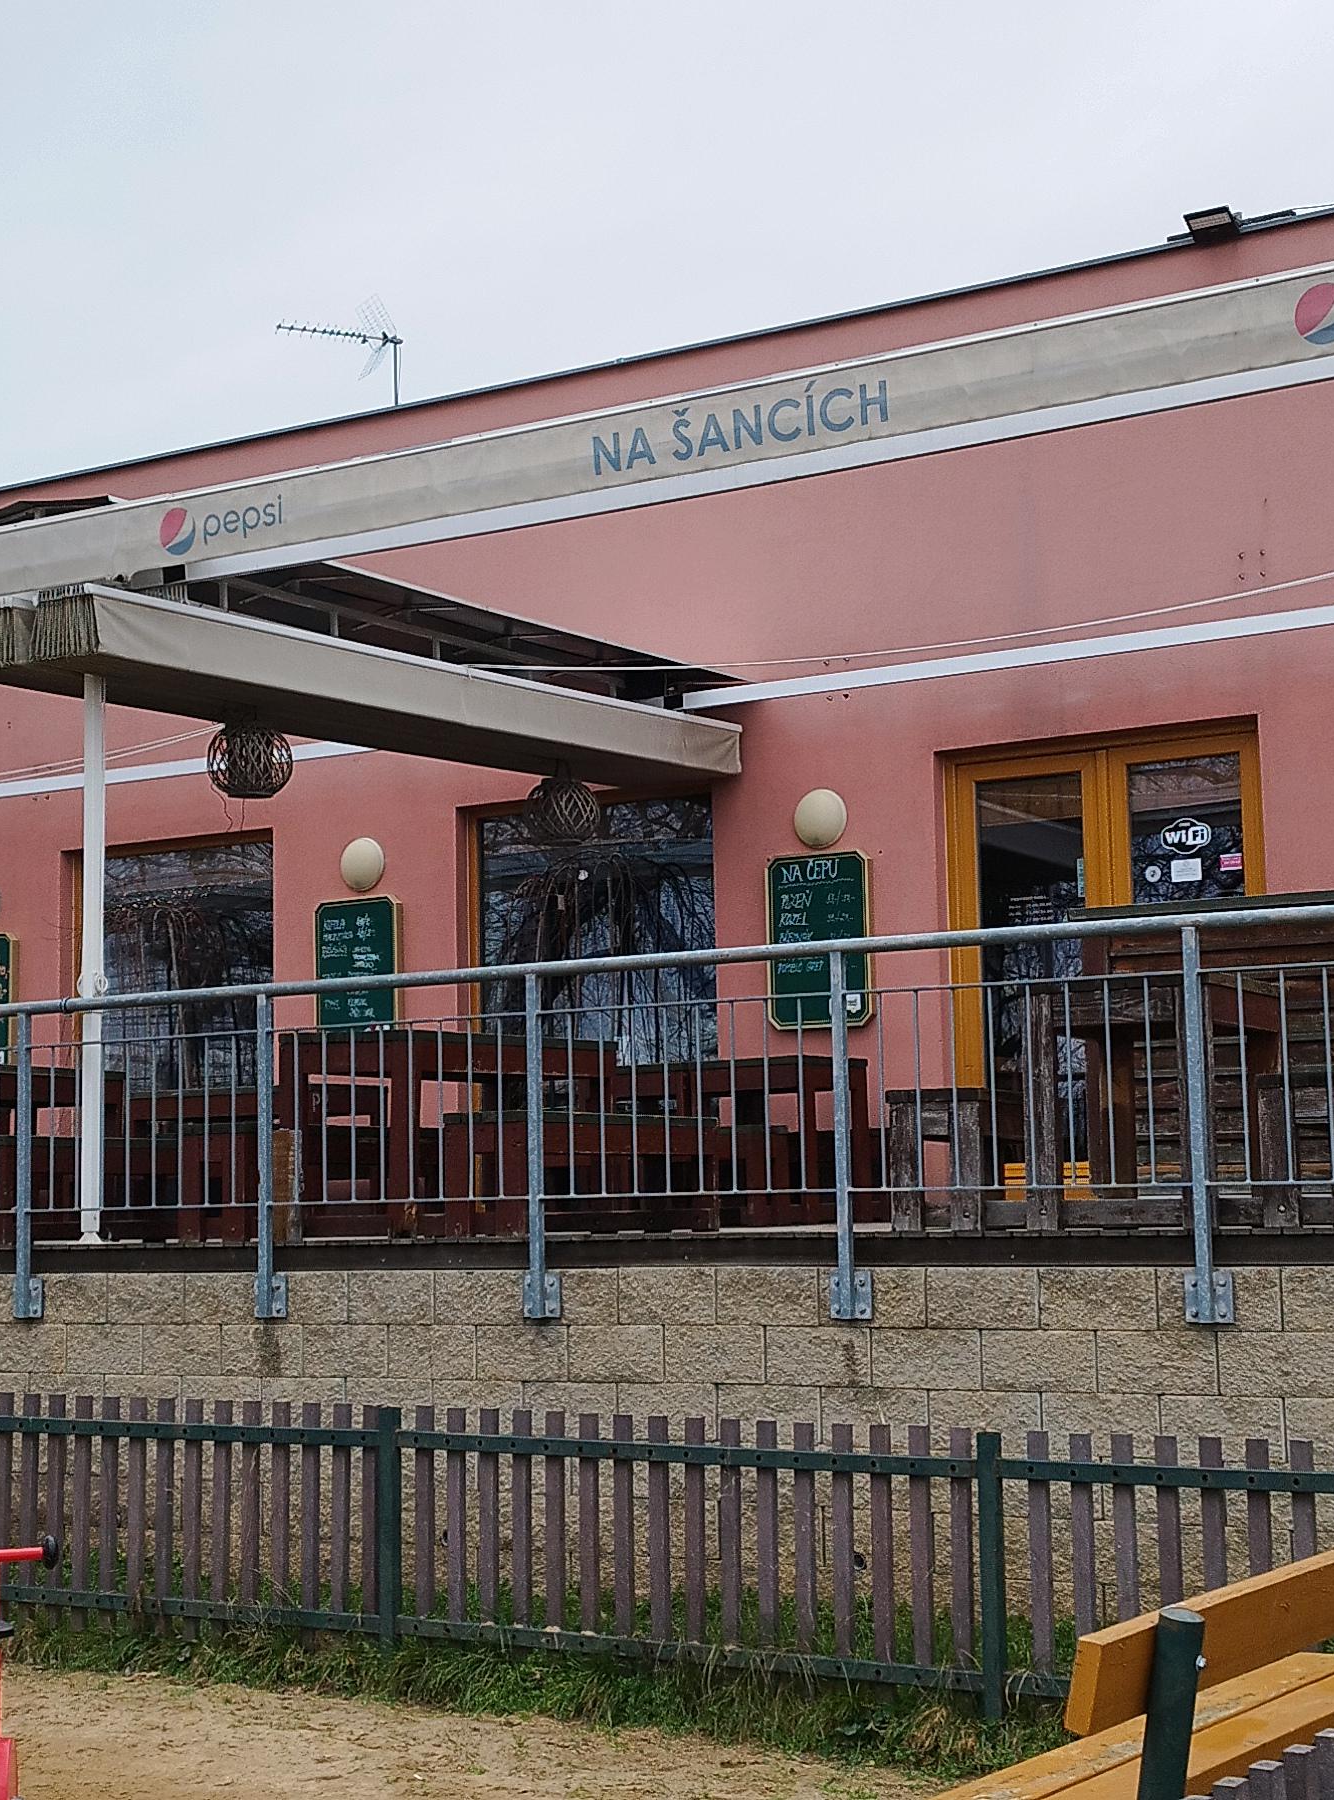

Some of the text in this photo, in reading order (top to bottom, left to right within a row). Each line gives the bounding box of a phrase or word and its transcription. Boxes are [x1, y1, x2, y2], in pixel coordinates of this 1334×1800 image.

[592, 380, 888, 475] NA ŠANCÍCH
[203, 494, 282, 545] pepsi
[1164, 828, 1206, 845] WiFi
[780, 858, 839, 884] NA ČEPU
